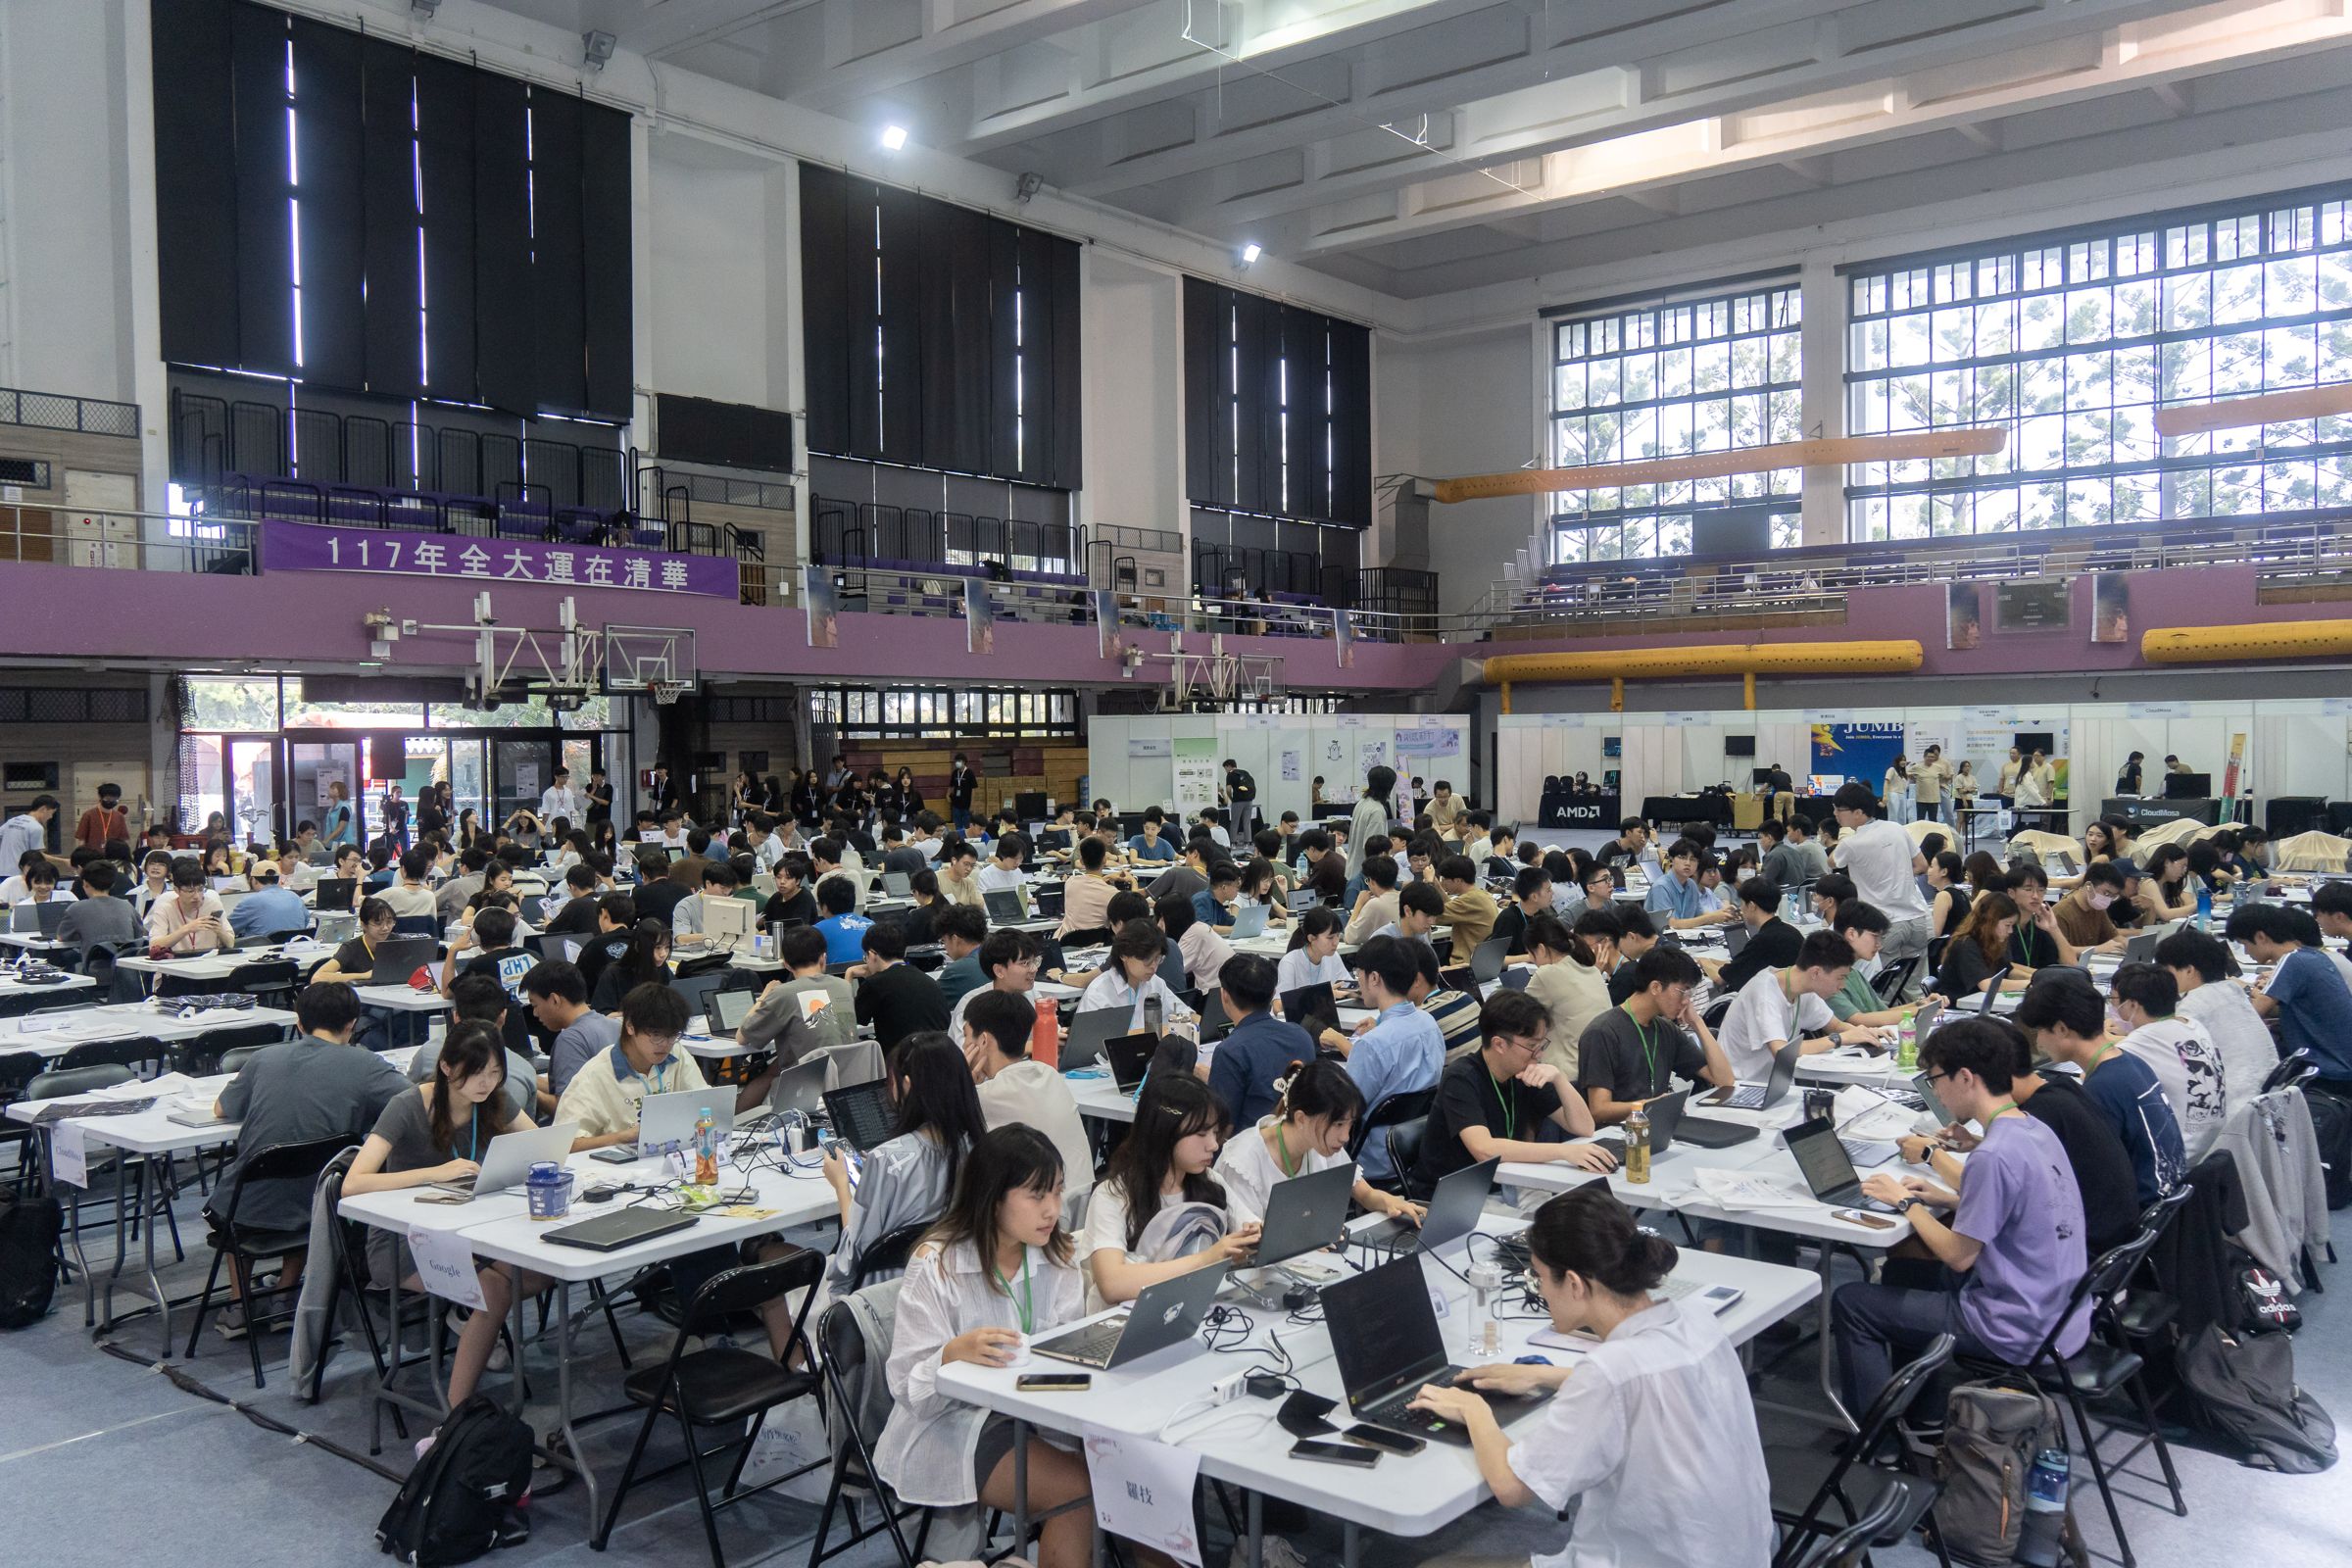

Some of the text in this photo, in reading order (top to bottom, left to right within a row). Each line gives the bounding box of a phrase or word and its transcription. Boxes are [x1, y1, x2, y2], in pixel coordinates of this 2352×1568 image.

[326, 536, 688, 590] 117年全大運在清華
[1556, 806, 1589, 818] AMD
[2140, 808, 2180, 817] CloudMosa
[429, 1259, 462, 1278] Google
[2259, 1302, 2297, 1313] adidas
